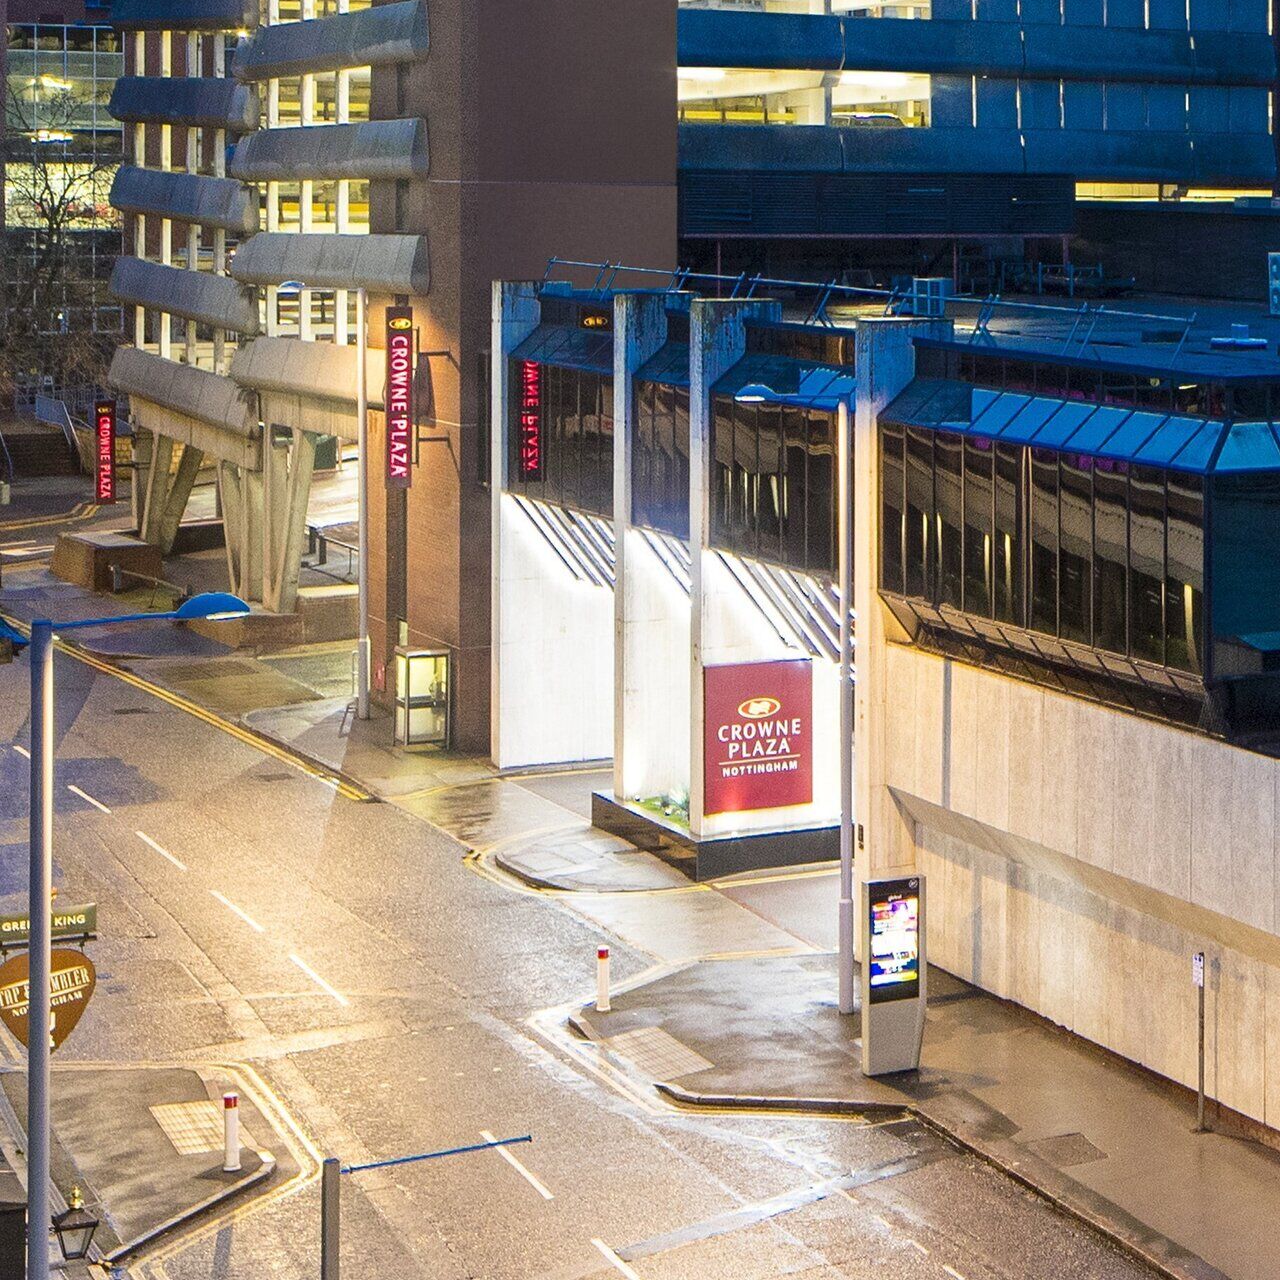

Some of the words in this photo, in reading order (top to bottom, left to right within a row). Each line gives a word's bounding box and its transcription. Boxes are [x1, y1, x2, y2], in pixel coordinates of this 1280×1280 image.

[391, 335, 408, 412] CROWNE
[100, 416, 111, 461] CROWNE
[390, 419, 408, 477] PLAZA
[100, 464, 111, 498] PLAZA
[718, 718, 801, 742] CROWNE
[728, 737, 791, 759] PLAZA
[722, 760, 798, 777] NOTTINGHAM
[54, 914, 86, 926] KING
[50, 968, 91, 992] MBLER
